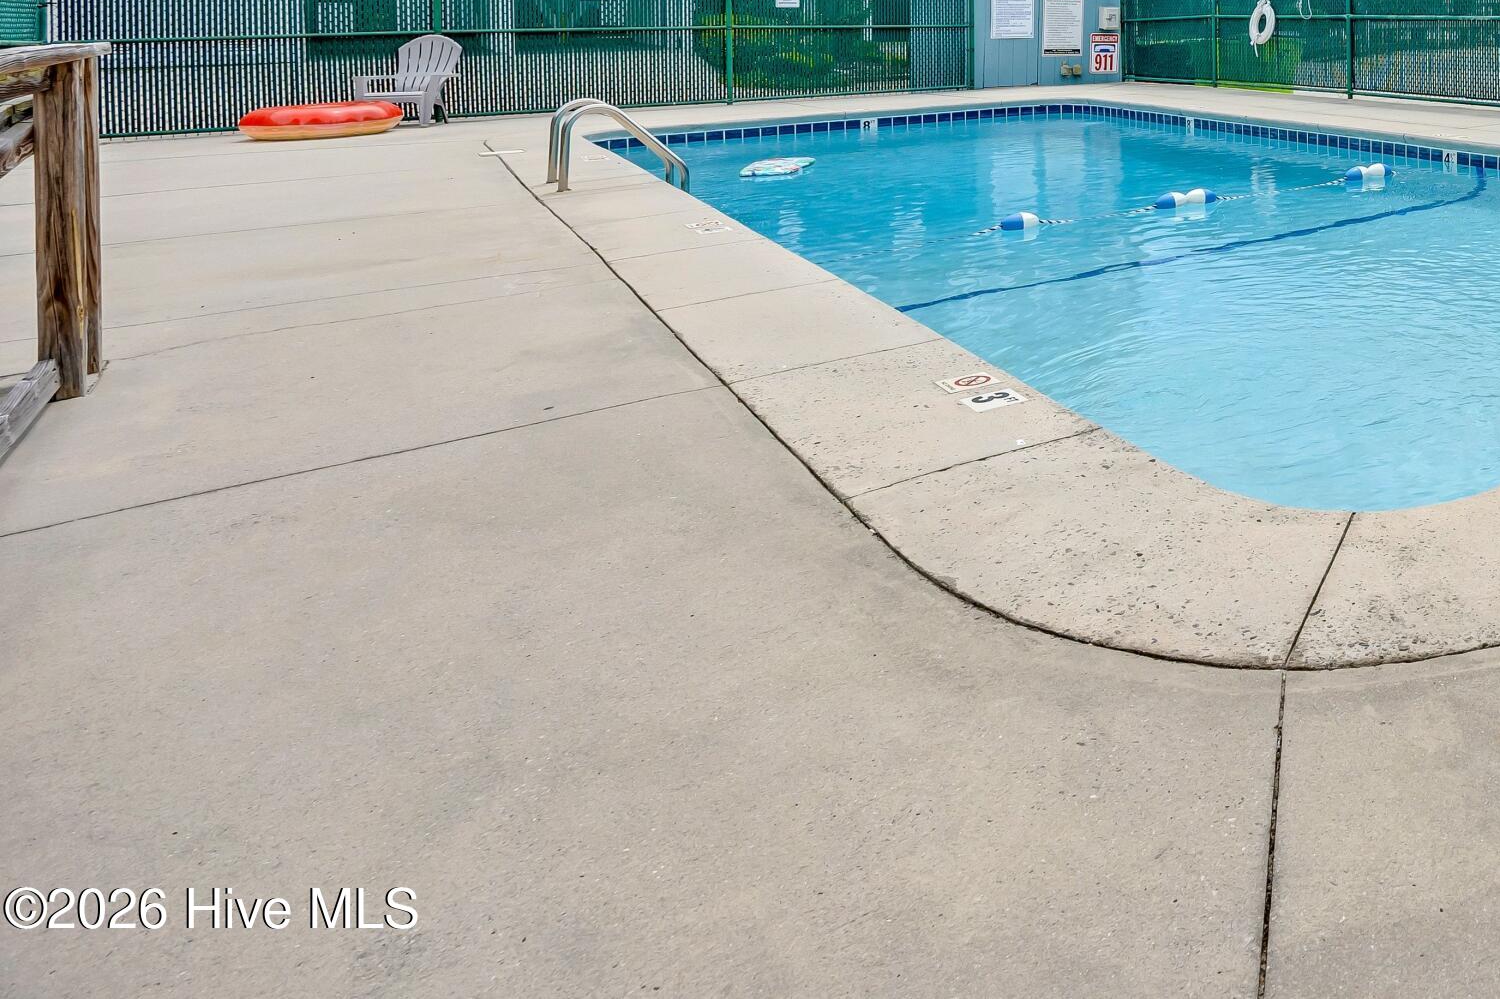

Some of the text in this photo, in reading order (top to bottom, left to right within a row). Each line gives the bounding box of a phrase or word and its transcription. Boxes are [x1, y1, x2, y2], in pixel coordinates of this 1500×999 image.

[1095, 53, 1114, 71] 911
[863, 120, 871, 128] 8
[971, 391, 1010, 404] 3
